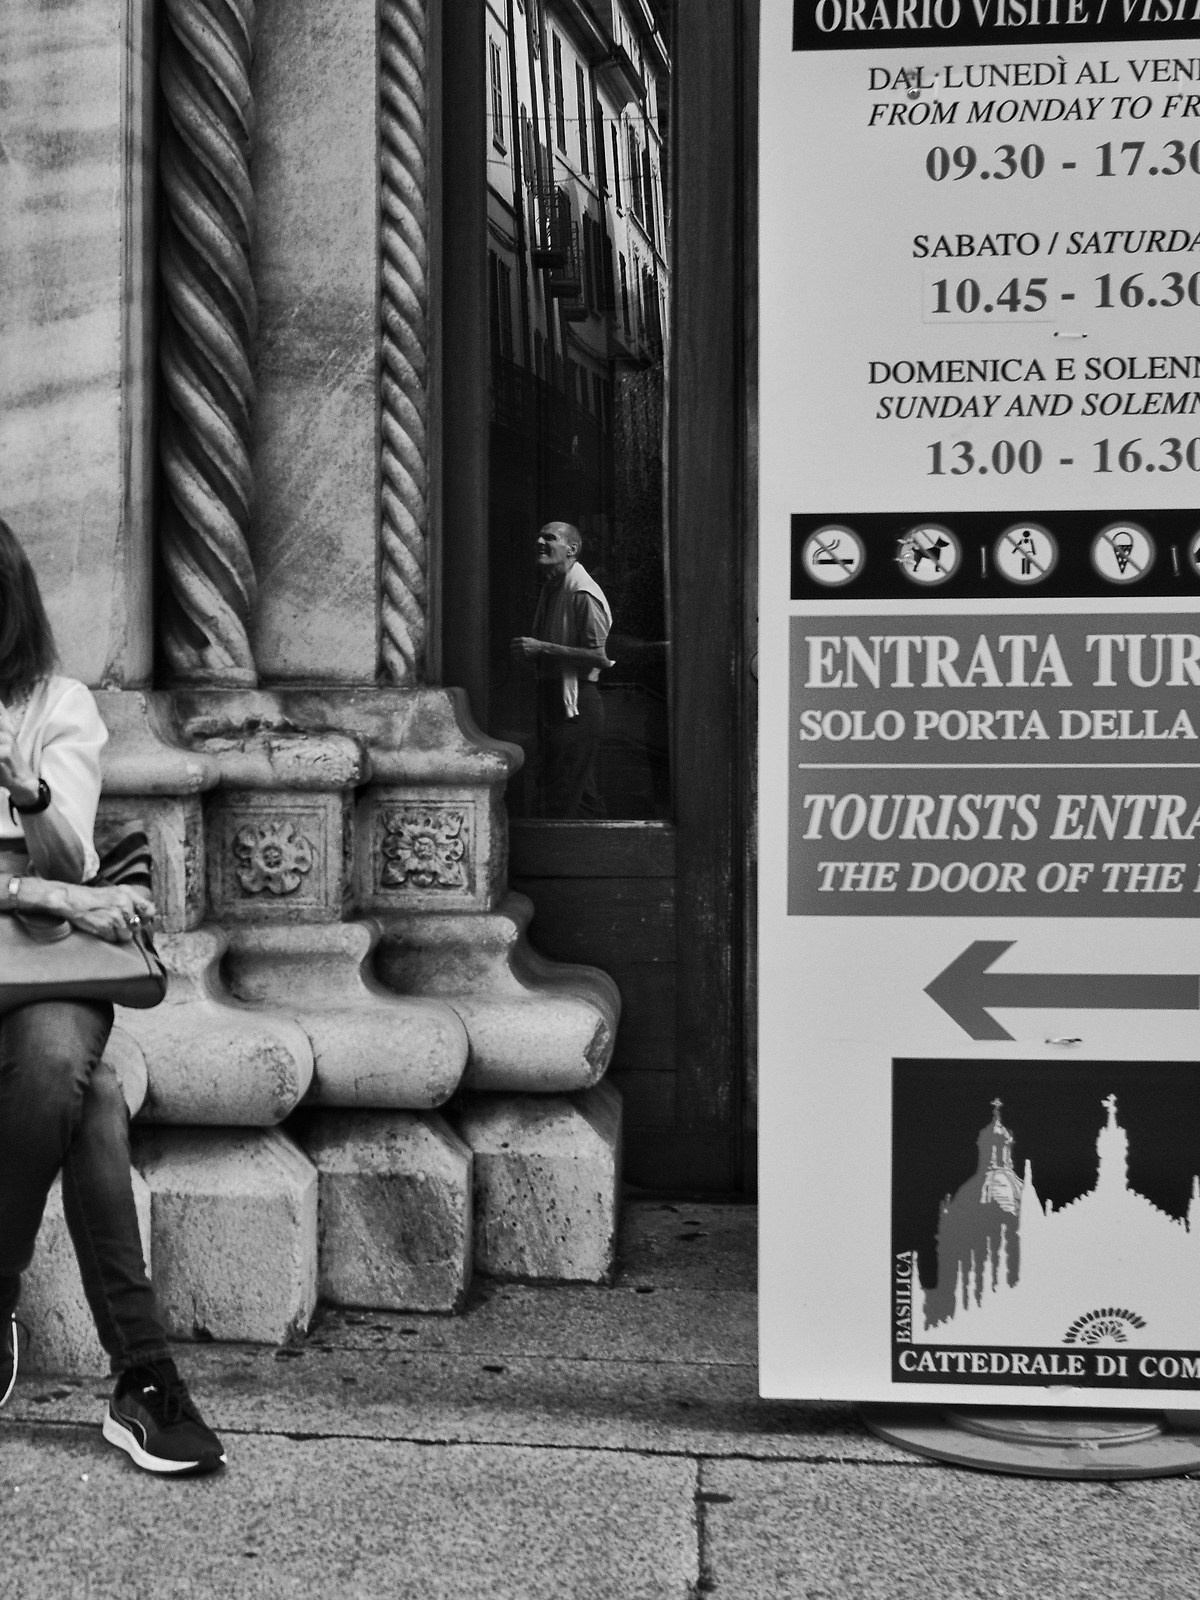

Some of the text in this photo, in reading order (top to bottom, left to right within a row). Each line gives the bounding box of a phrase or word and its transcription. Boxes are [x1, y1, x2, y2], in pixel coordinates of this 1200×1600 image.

[815, 0, 961, 32] ORARIO
[972, 0, 1089, 27] VISITE
[1123, 0, 1200, 23] VISI
[868, 55, 1200, 91] DAL LUNEDÌ AL VEN
[867, 99, 960, 127] FROM
[965, 97, 1105, 124] MONDAY
[1111, 95, 1153, 120] TO
[925, 143, 1045, 182] 09.30
[1062, 162, 1077, 170] -
[912, 232, 1041, 259] SABATO
[931, 277, 1048, 314] 10.45
[1061, 293, 1075, 301] -
[868, 358, 1047, 385] DOMENICA
[1055, 357, 1076, 381] E
[876, 394, 1002, 420] SUNDAY
[1004, 393, 1074, 417] AND
[927, 439, 1043, 476] 13.00
[803, 633, 1200, 689] ENTRATA TUR
[799, 708, 1199, 741] SOLO PORTA DELLA
[802, 793, 1041, 841] TOURISTS
[817, 861, 901, 892] THE
[906, 861, 1027, 893] DOOR
[1036, 861, 1095, 893] OF
[1101, 862, 1187, 893] THE
[895, 1251, 912, 1343] BASILICA
[898, 1349, 1200, 1379] CATTEDRALE DI COM
